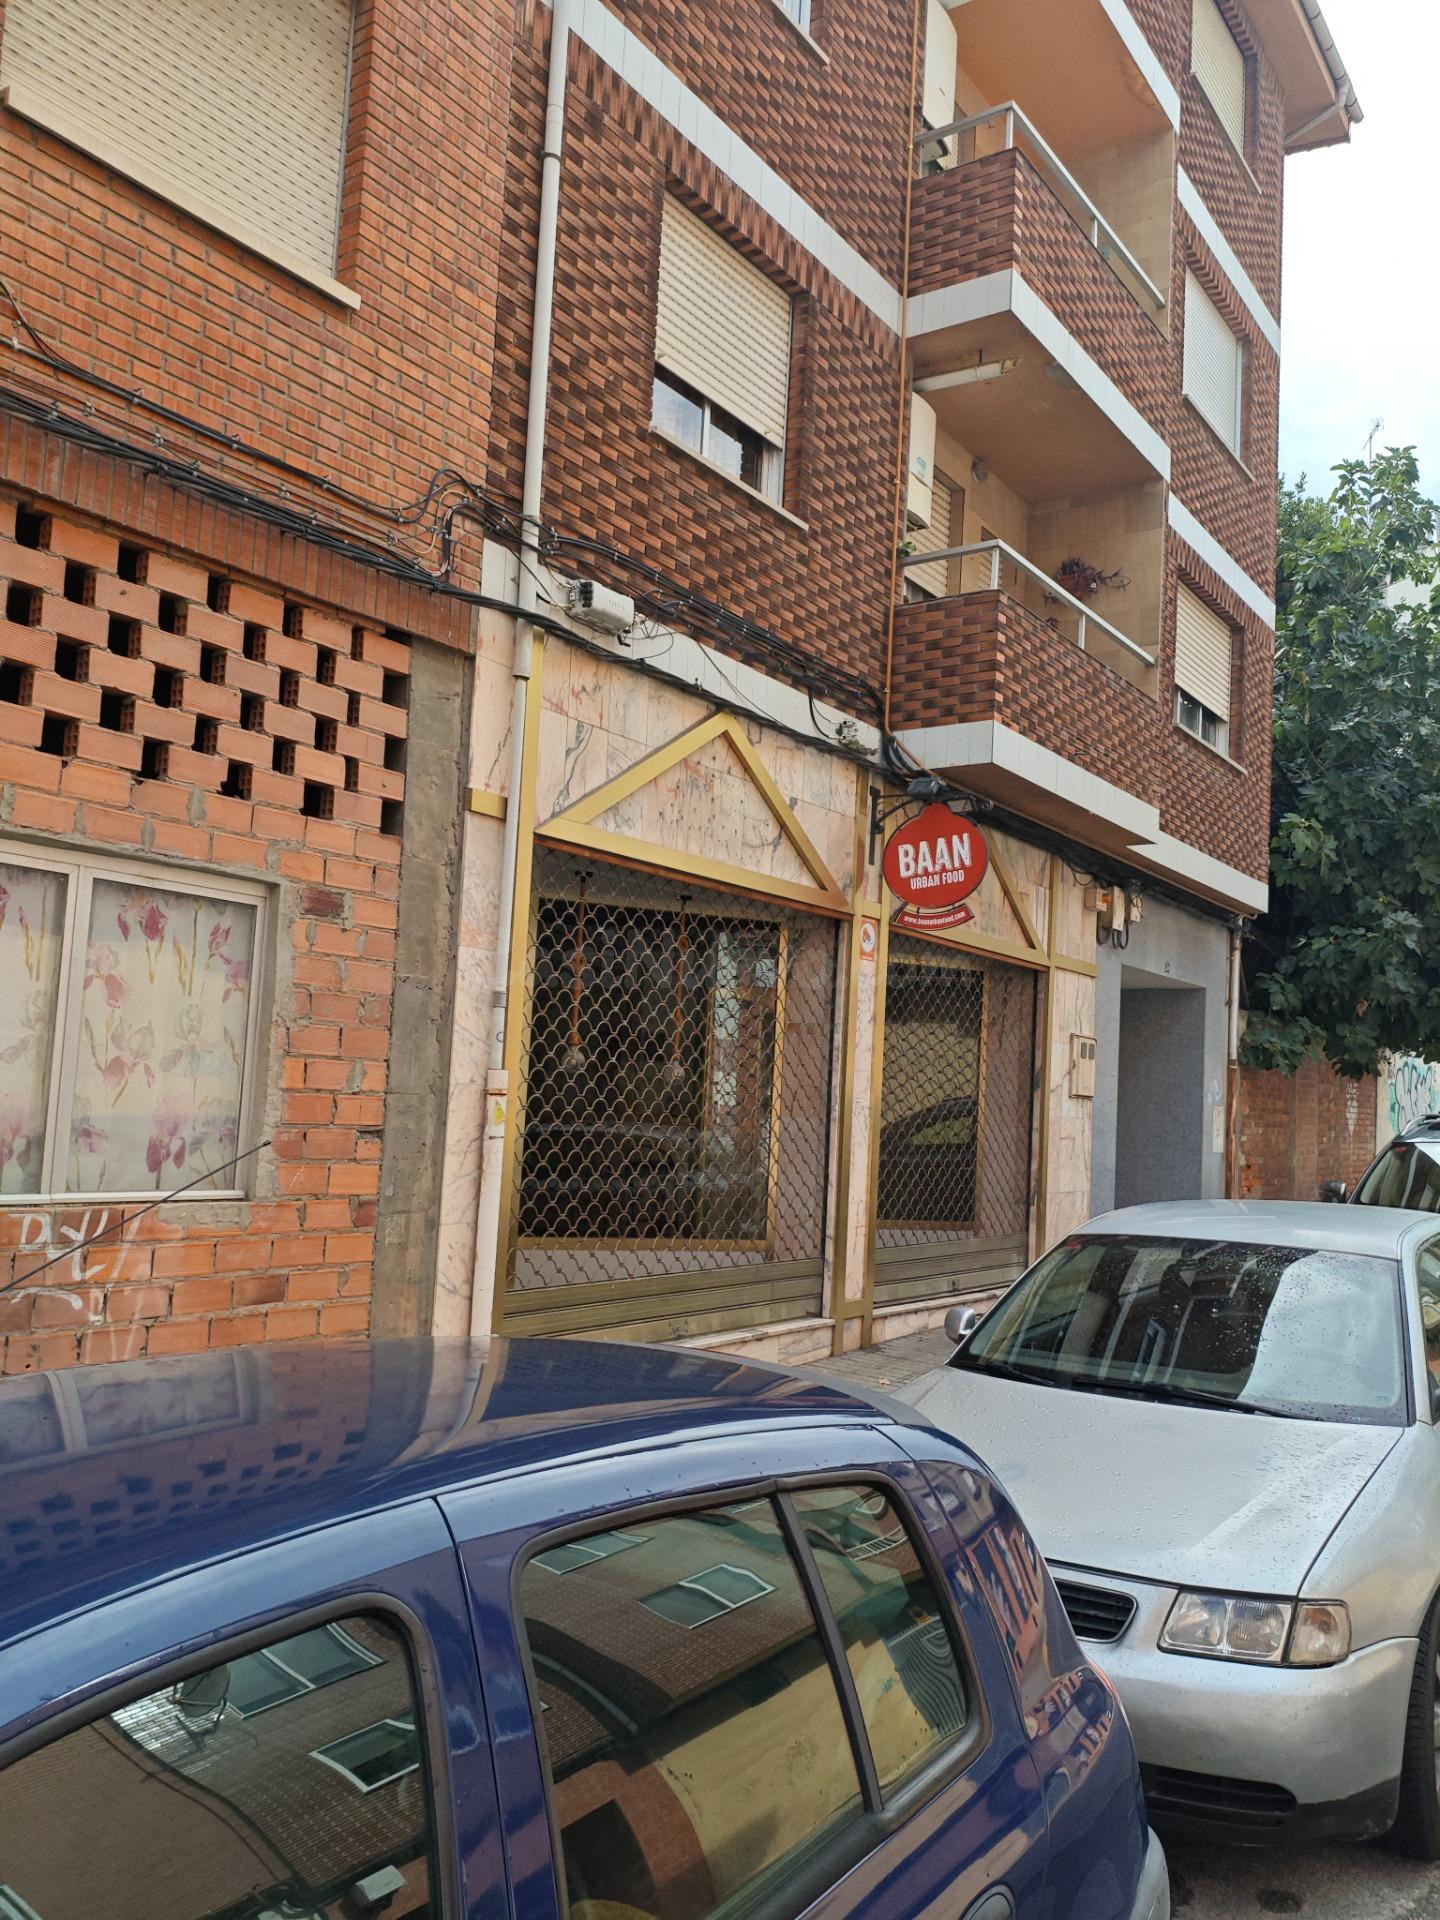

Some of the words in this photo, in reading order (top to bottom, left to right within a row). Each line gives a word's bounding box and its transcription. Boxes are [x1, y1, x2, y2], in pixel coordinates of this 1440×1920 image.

[898, 833, 972, 877] BAAN
[910, 874, 940, 889] URBAN
[942, 870, 964, 884] FOOD
